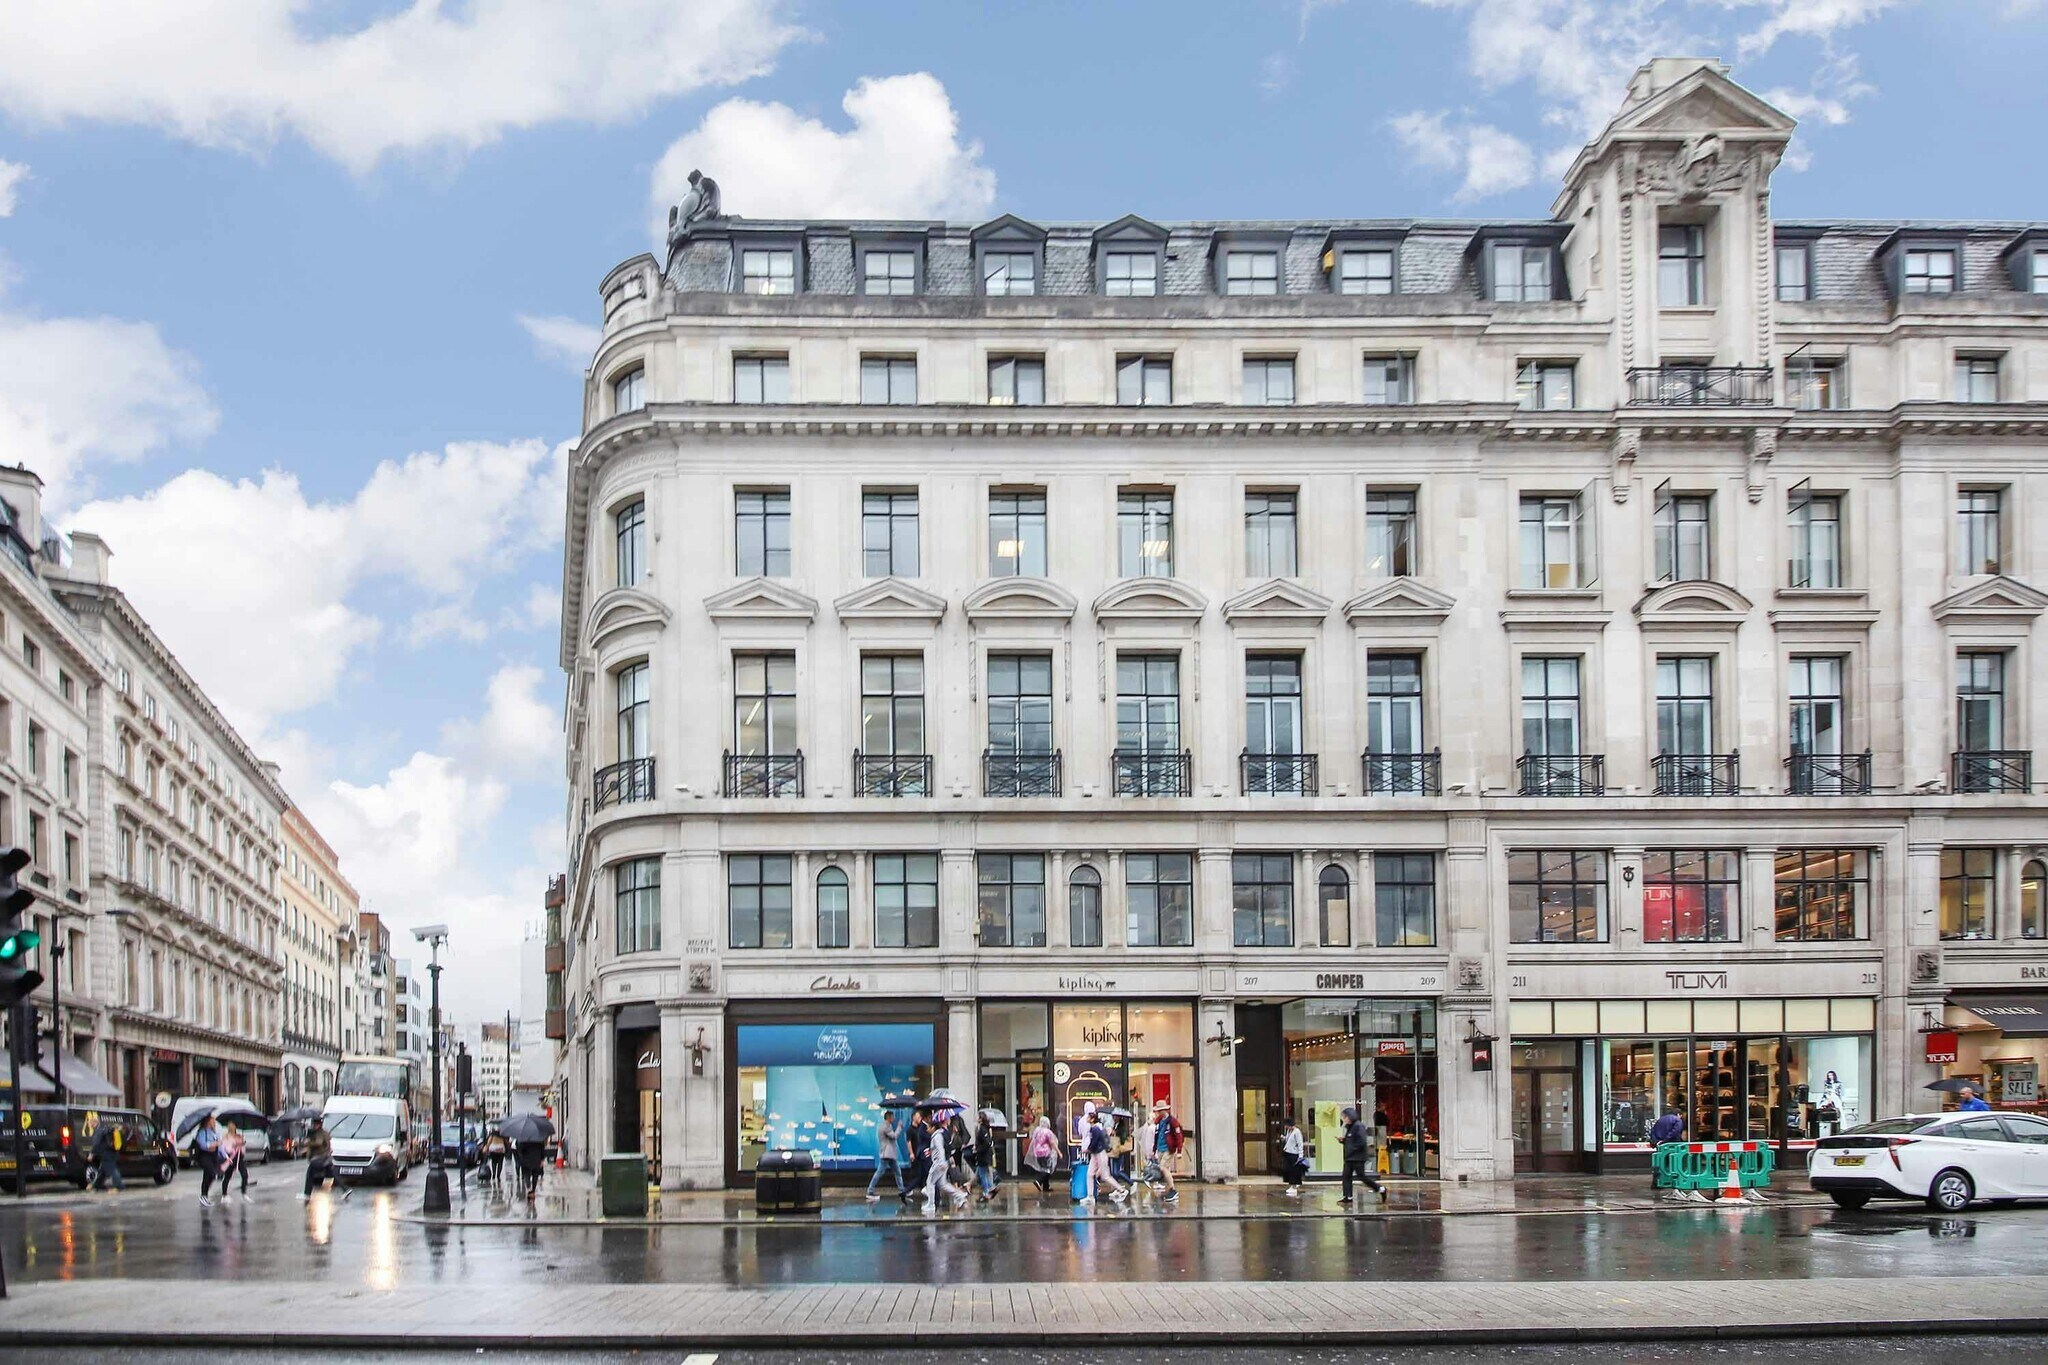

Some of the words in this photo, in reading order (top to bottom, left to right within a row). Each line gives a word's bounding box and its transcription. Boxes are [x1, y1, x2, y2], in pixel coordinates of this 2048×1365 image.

[2021, 966, 2048, 978] BAR
[810, 975, 861, 990] Clarks
[1059, 976, 1102, 992] kipling
[1243, 976, 1258, 985] 207
[1316, 974, 1364, 989] CAMPER
[1420, 976, 1436, 986] 209
[1512, 976, 1527, 987] 211
[1666, 971, 1727, 989] TUMI
[1862, 973, 1877, 984] 213
[1971, 1007, 2043, 1016] BARKER
[1380, 1042, 1405, 1053] CAMPER
[1525, 1048, 1546, 1060] 211
[1926, 1053, 1956, 1062] TUMI
[2008, 1082, 2033, 1096] SALE
